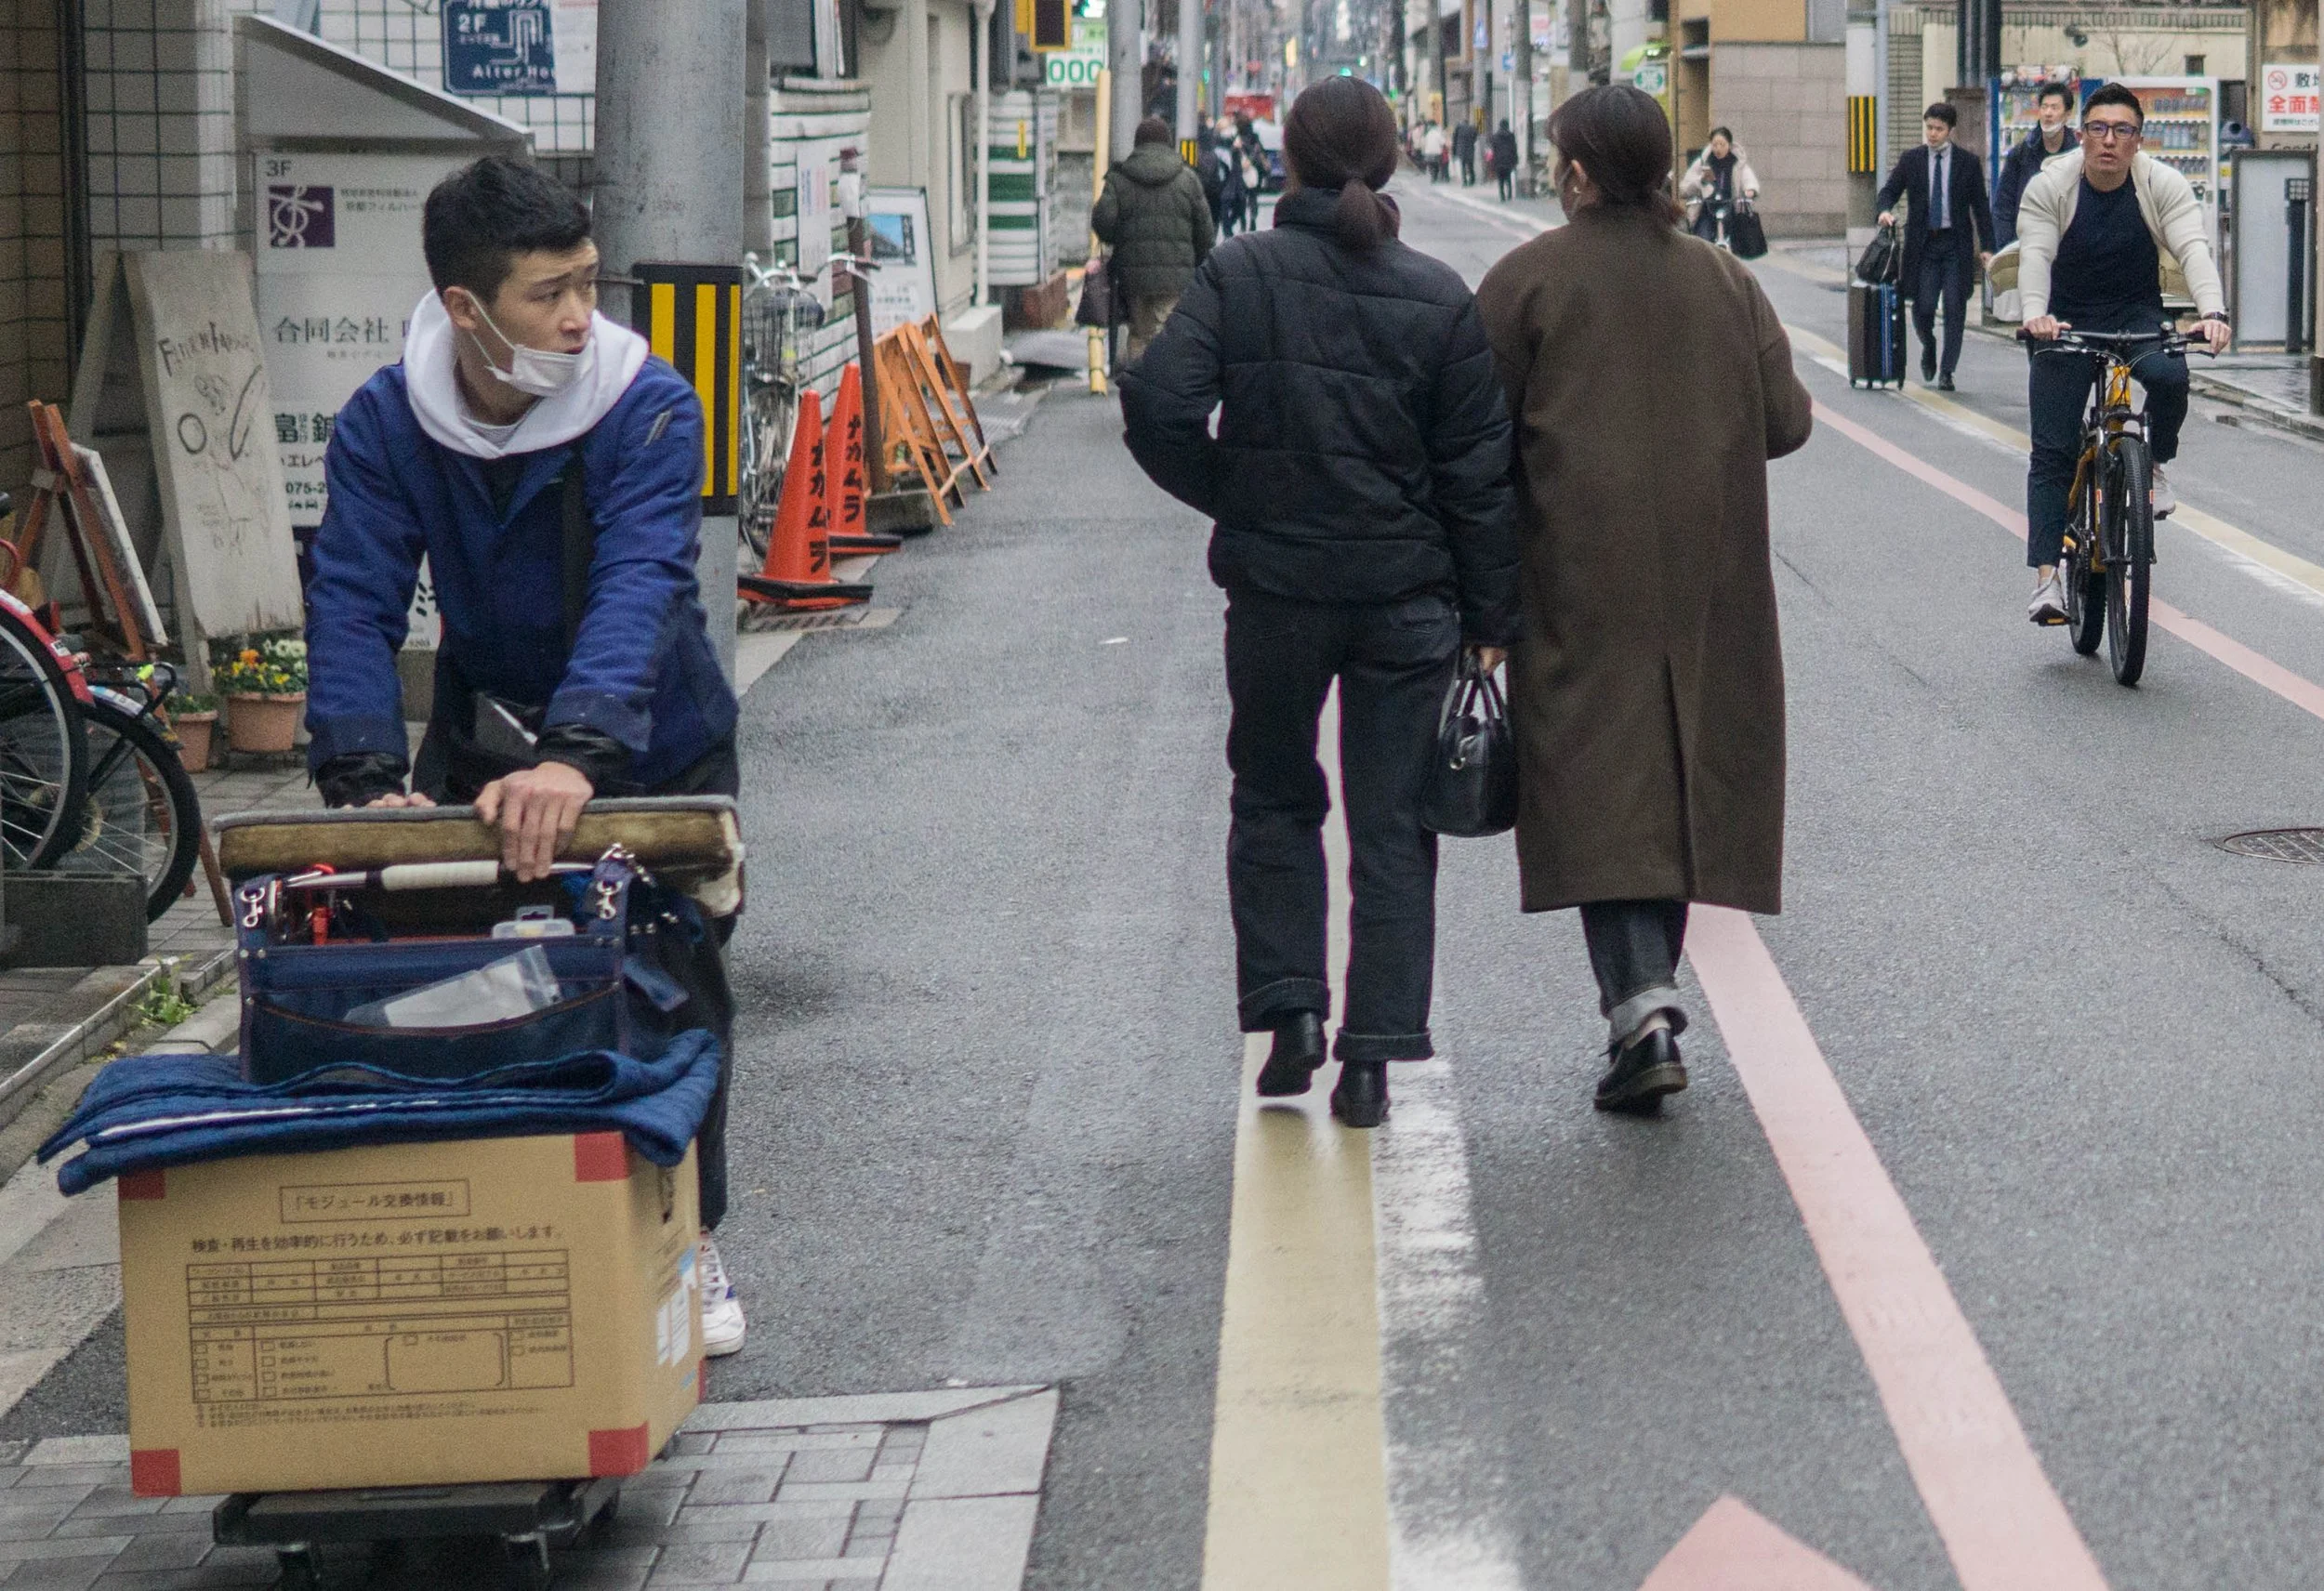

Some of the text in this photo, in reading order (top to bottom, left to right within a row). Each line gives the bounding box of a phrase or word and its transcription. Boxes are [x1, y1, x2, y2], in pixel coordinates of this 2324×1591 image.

[458, 13, 487, 33] 2F
[266, 160, 291, 177] 3F
[274, 316, 390, 344] 合同会社
[843, 414, 863, 522] ナカムラ
